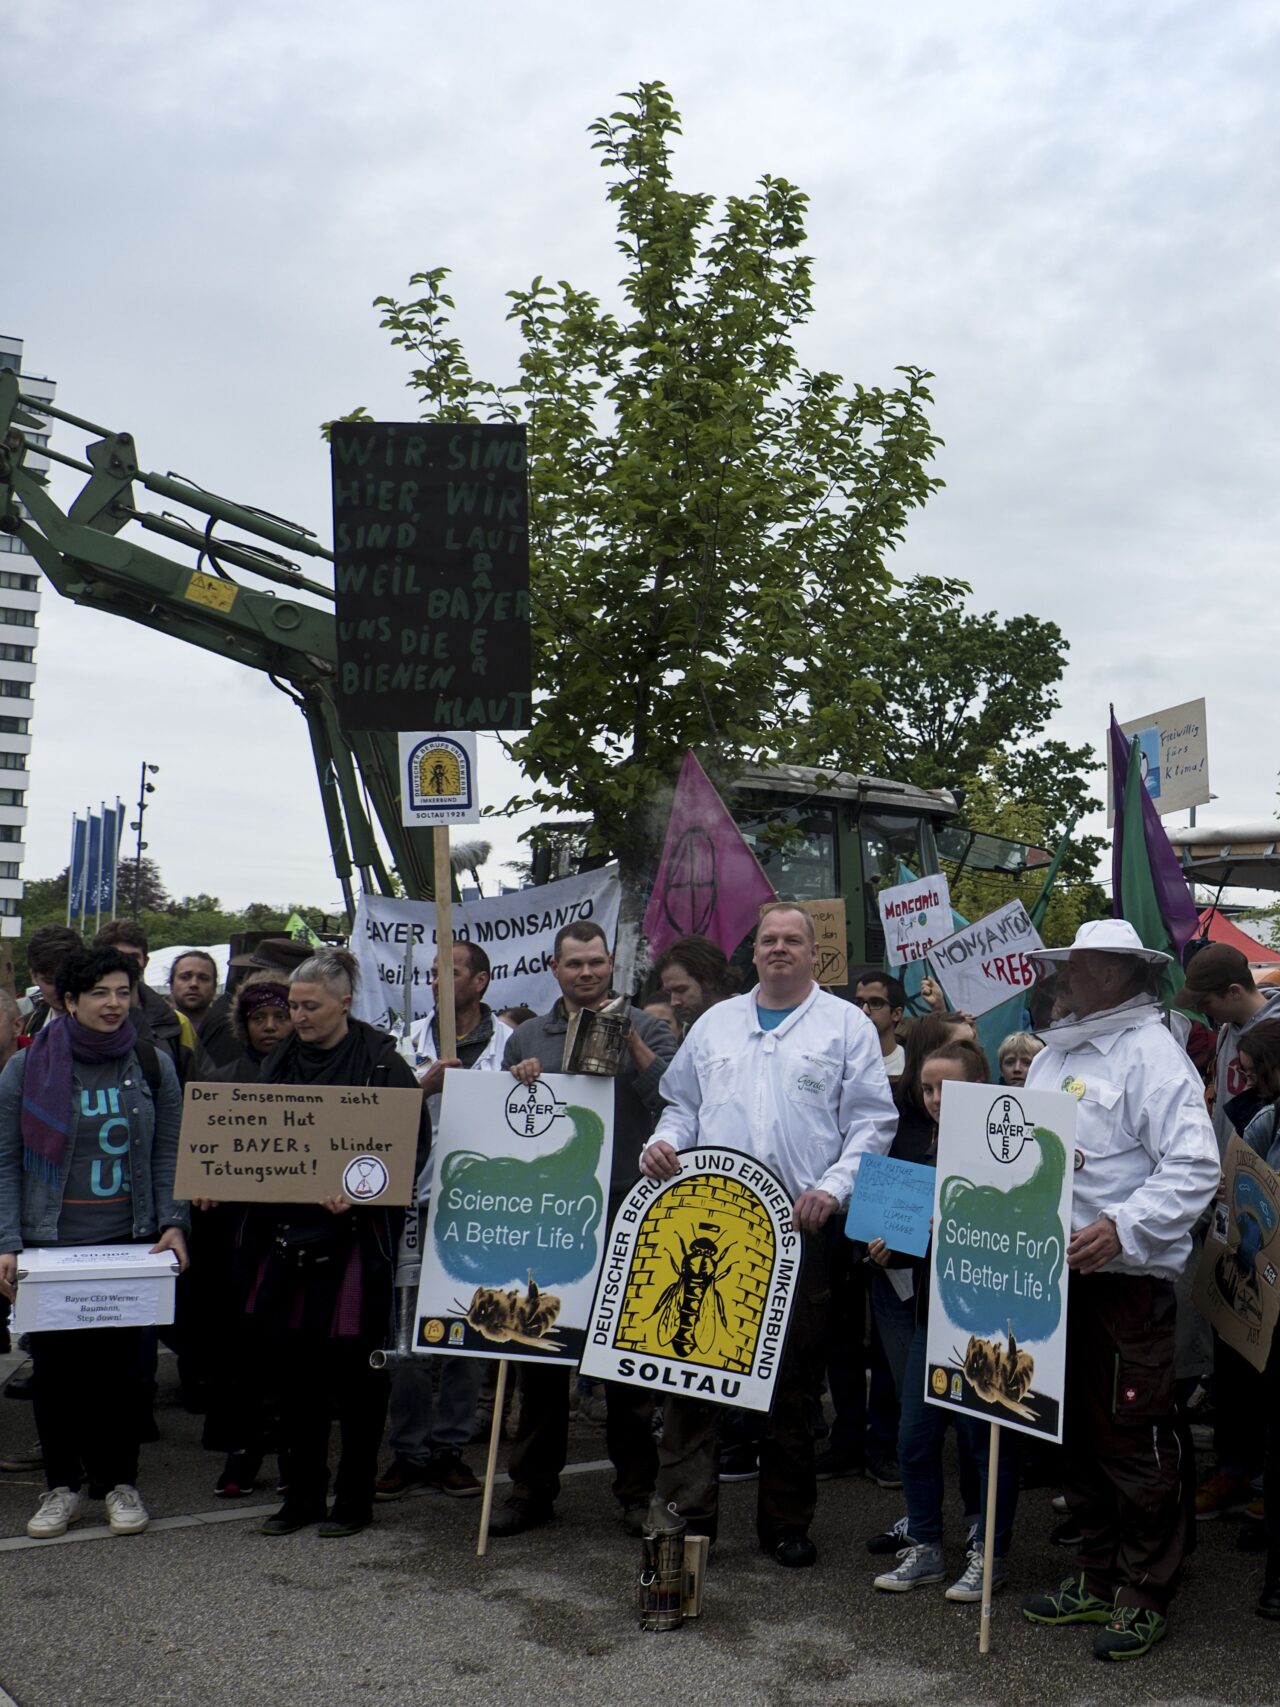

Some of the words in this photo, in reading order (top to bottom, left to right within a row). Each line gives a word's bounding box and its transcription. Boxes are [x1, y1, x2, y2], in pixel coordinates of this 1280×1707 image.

[445, 525, 526, 555] LAUT
[339, 615, 392, 642] UNS
[434, 692, 532, 730] KLAUT
[883, 889, 940, 920] Monsanto
[475, 898, 595, 944] MONSANTO
[513, 950, 553, 977] Ack
[191, 1087, 220, 1101] Der
[231, 1087, 324, 1104] Sensenmann
[340, 1092, 380, 1106] zieht
[508, 1103, 554, 1115] BAYER
[207, 1108, 268, 1127] seinen
[283, 1109, 316, 1127] Hut
[988, 1122, 1024, 1138] BAYER
[190, 1140, 220, 1155] vor
[329, 1136, 393, 1153] blinder
[201, 1158, 318, 1183] Tötungswut!
[694, 1154, 735, 1174] UND
[447, 1187, 534, 1214] Science
[540, 1193, 576, 1217] For
[622, 1162, 690, 1225] BERU-
[443, 1221, 460, 1243] A
[465, 1221, 531, 1248] Better
[945, 1218, 1010, 1253] Science
[1016, 1231, 1043, 1260] For
[943, 1256, 956, 1281] A
[960, 1258, 1009, 1291] Better
[64, 1295, 89, 1304] Bayer
[593, 1230, 632, 1347] DEUTSCHER
[76, 1314, 95, 1323] Step
[756, 1257, 796, 1381] IMKERBUND
[616, 1357, 742, 1399] SOLTAU
